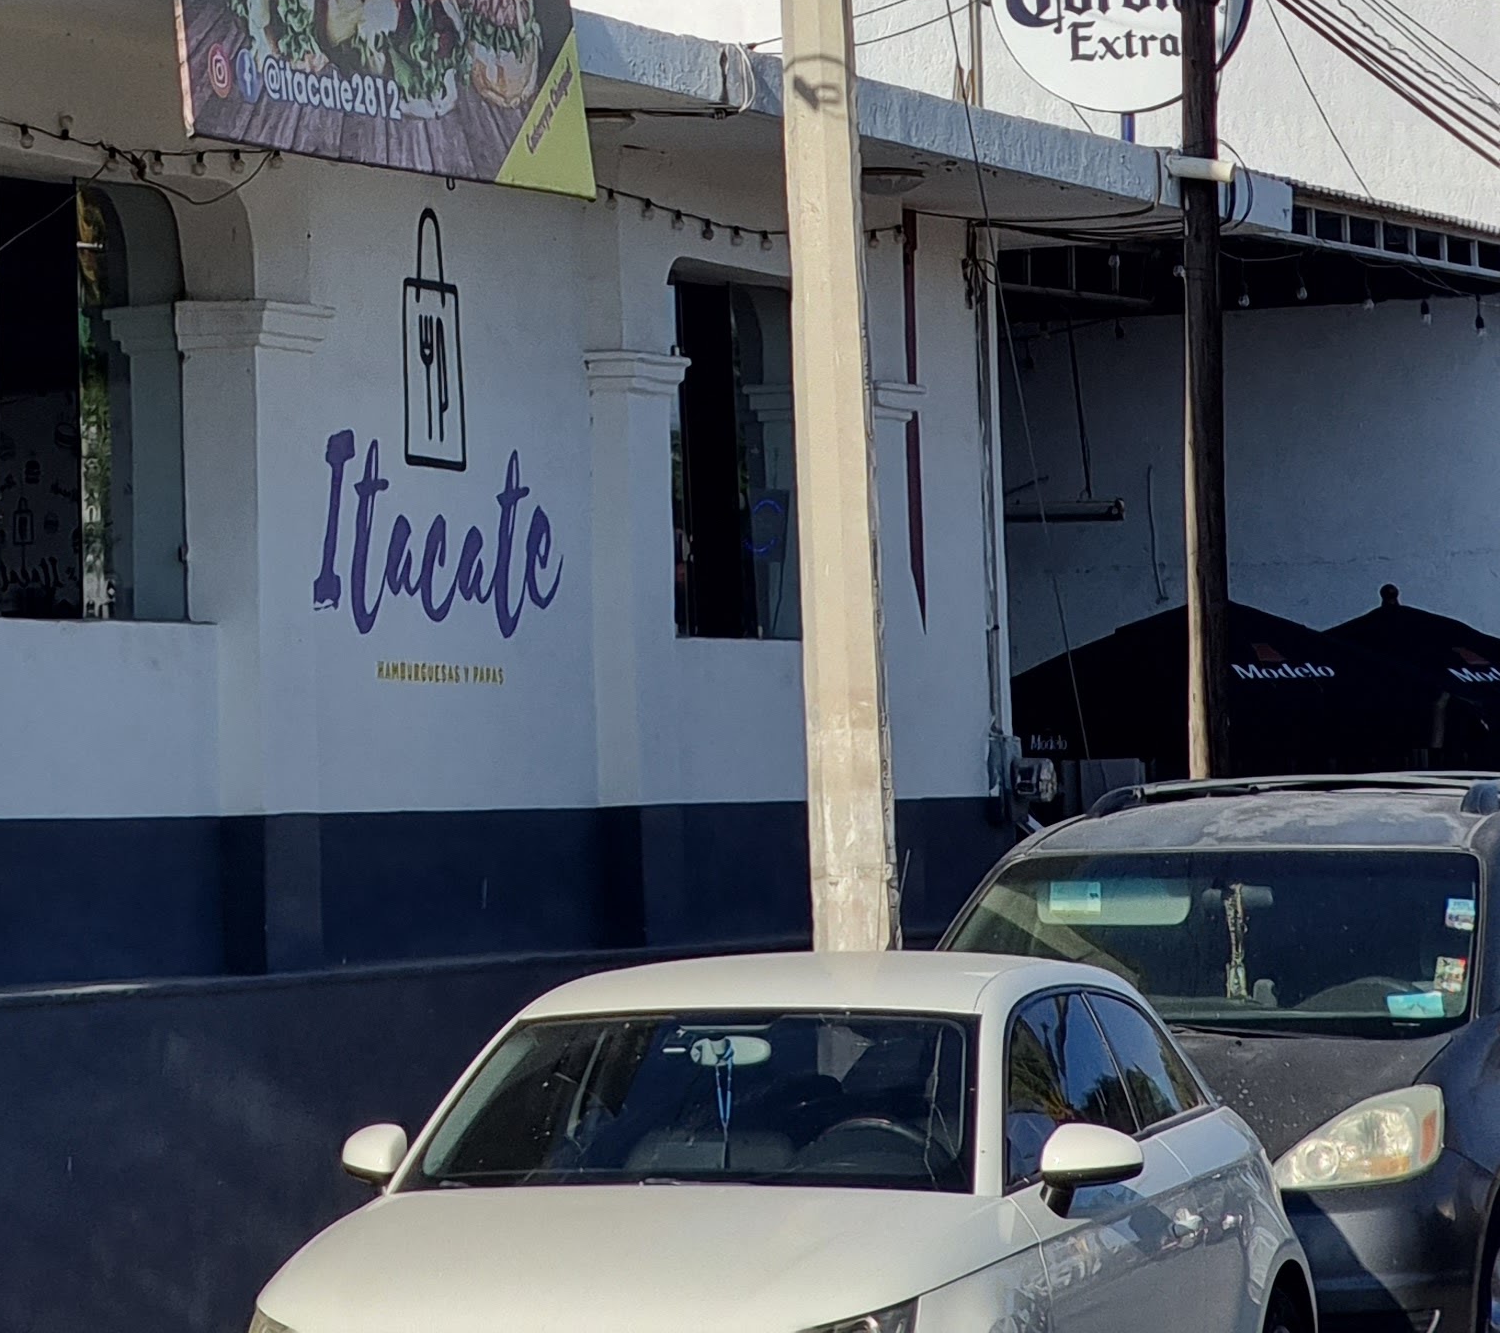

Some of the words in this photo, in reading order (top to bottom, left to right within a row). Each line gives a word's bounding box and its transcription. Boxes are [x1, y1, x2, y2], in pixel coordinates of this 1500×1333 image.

[1068, 20, 1182, 61] Extra
[263, 54, 402, 120] @itacate2812
[312, 429, 564, 638] Itacate
[376, 660, 461, 684] HAMBURGUESAS
[463, 664, 470, 683] Y
[473, 665, 504, 686] PAPAS
[1230, 661, 1336, 680] Modelo
